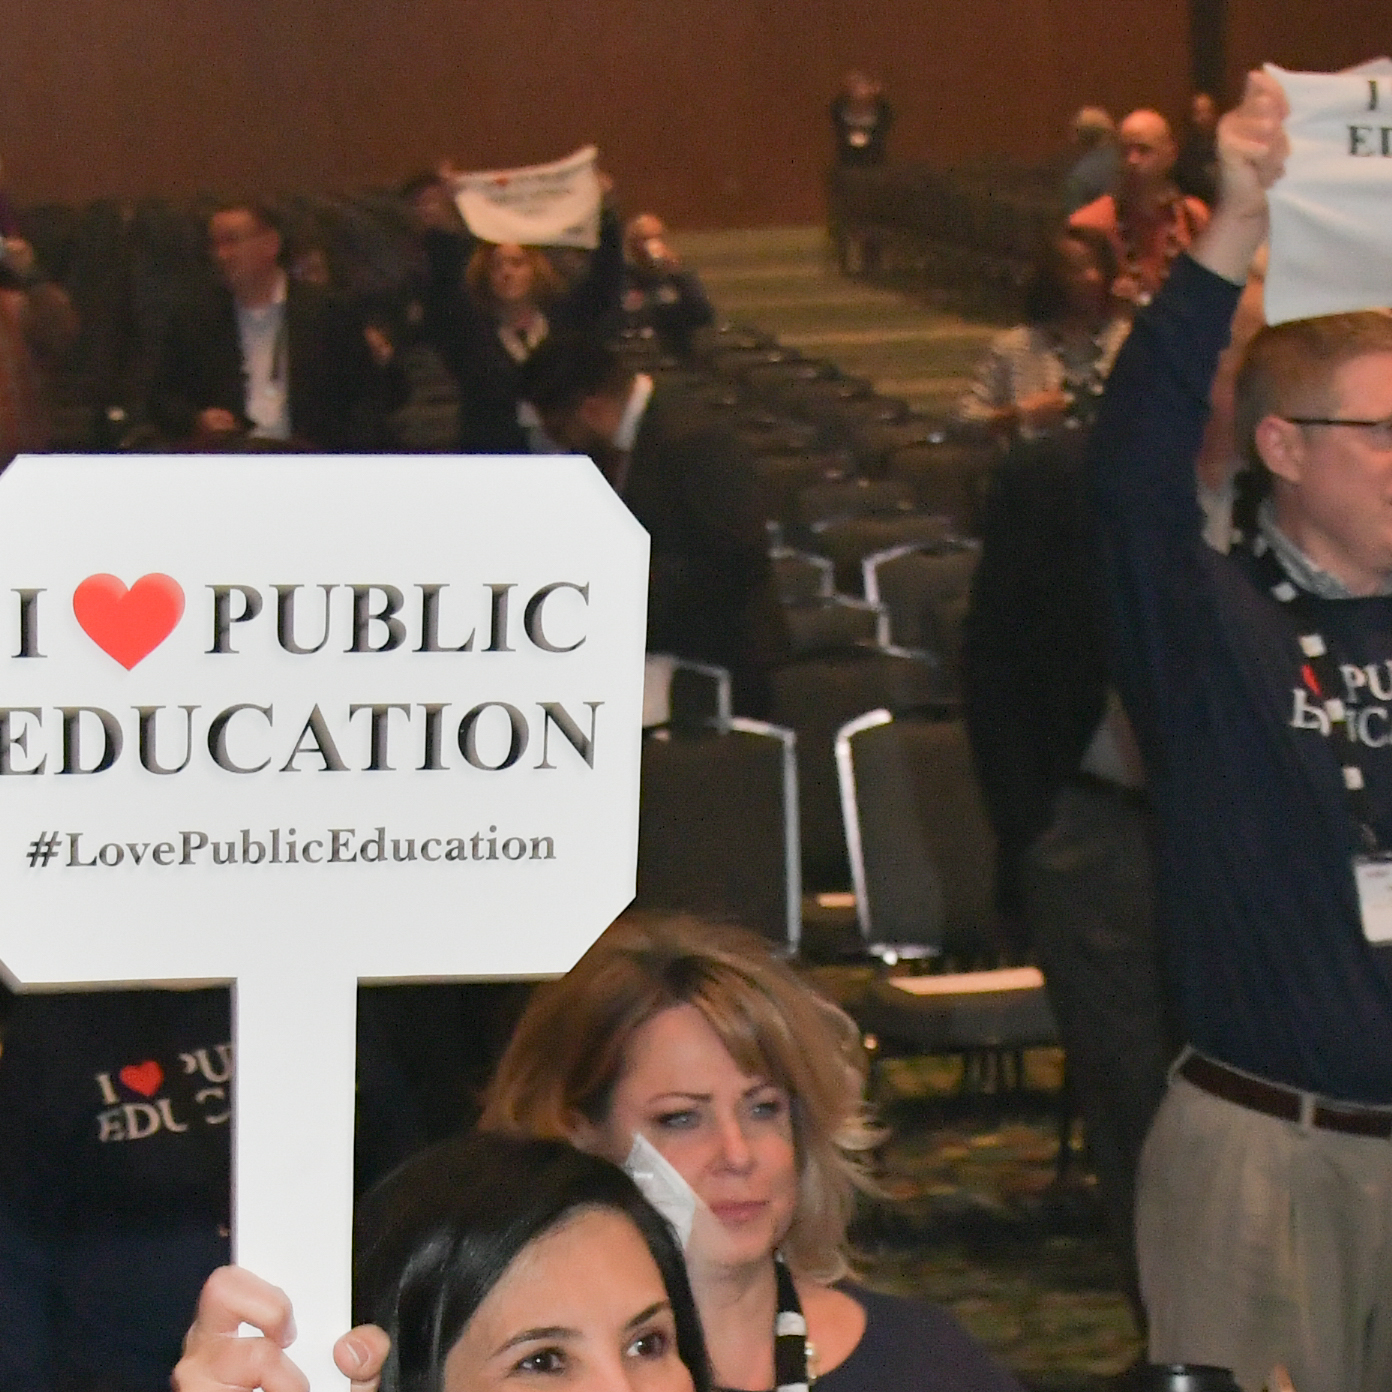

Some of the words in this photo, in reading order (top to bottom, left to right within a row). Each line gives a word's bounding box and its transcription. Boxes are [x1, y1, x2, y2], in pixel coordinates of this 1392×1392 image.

[1366, 79, 1380, 111] I
[11, 588, 47, 658] I
[204, 581, 591, 656] PUBLIC
[26, 825, 557, 869] #LovePublicEducation
[95, 1072, 118, 1105] I
